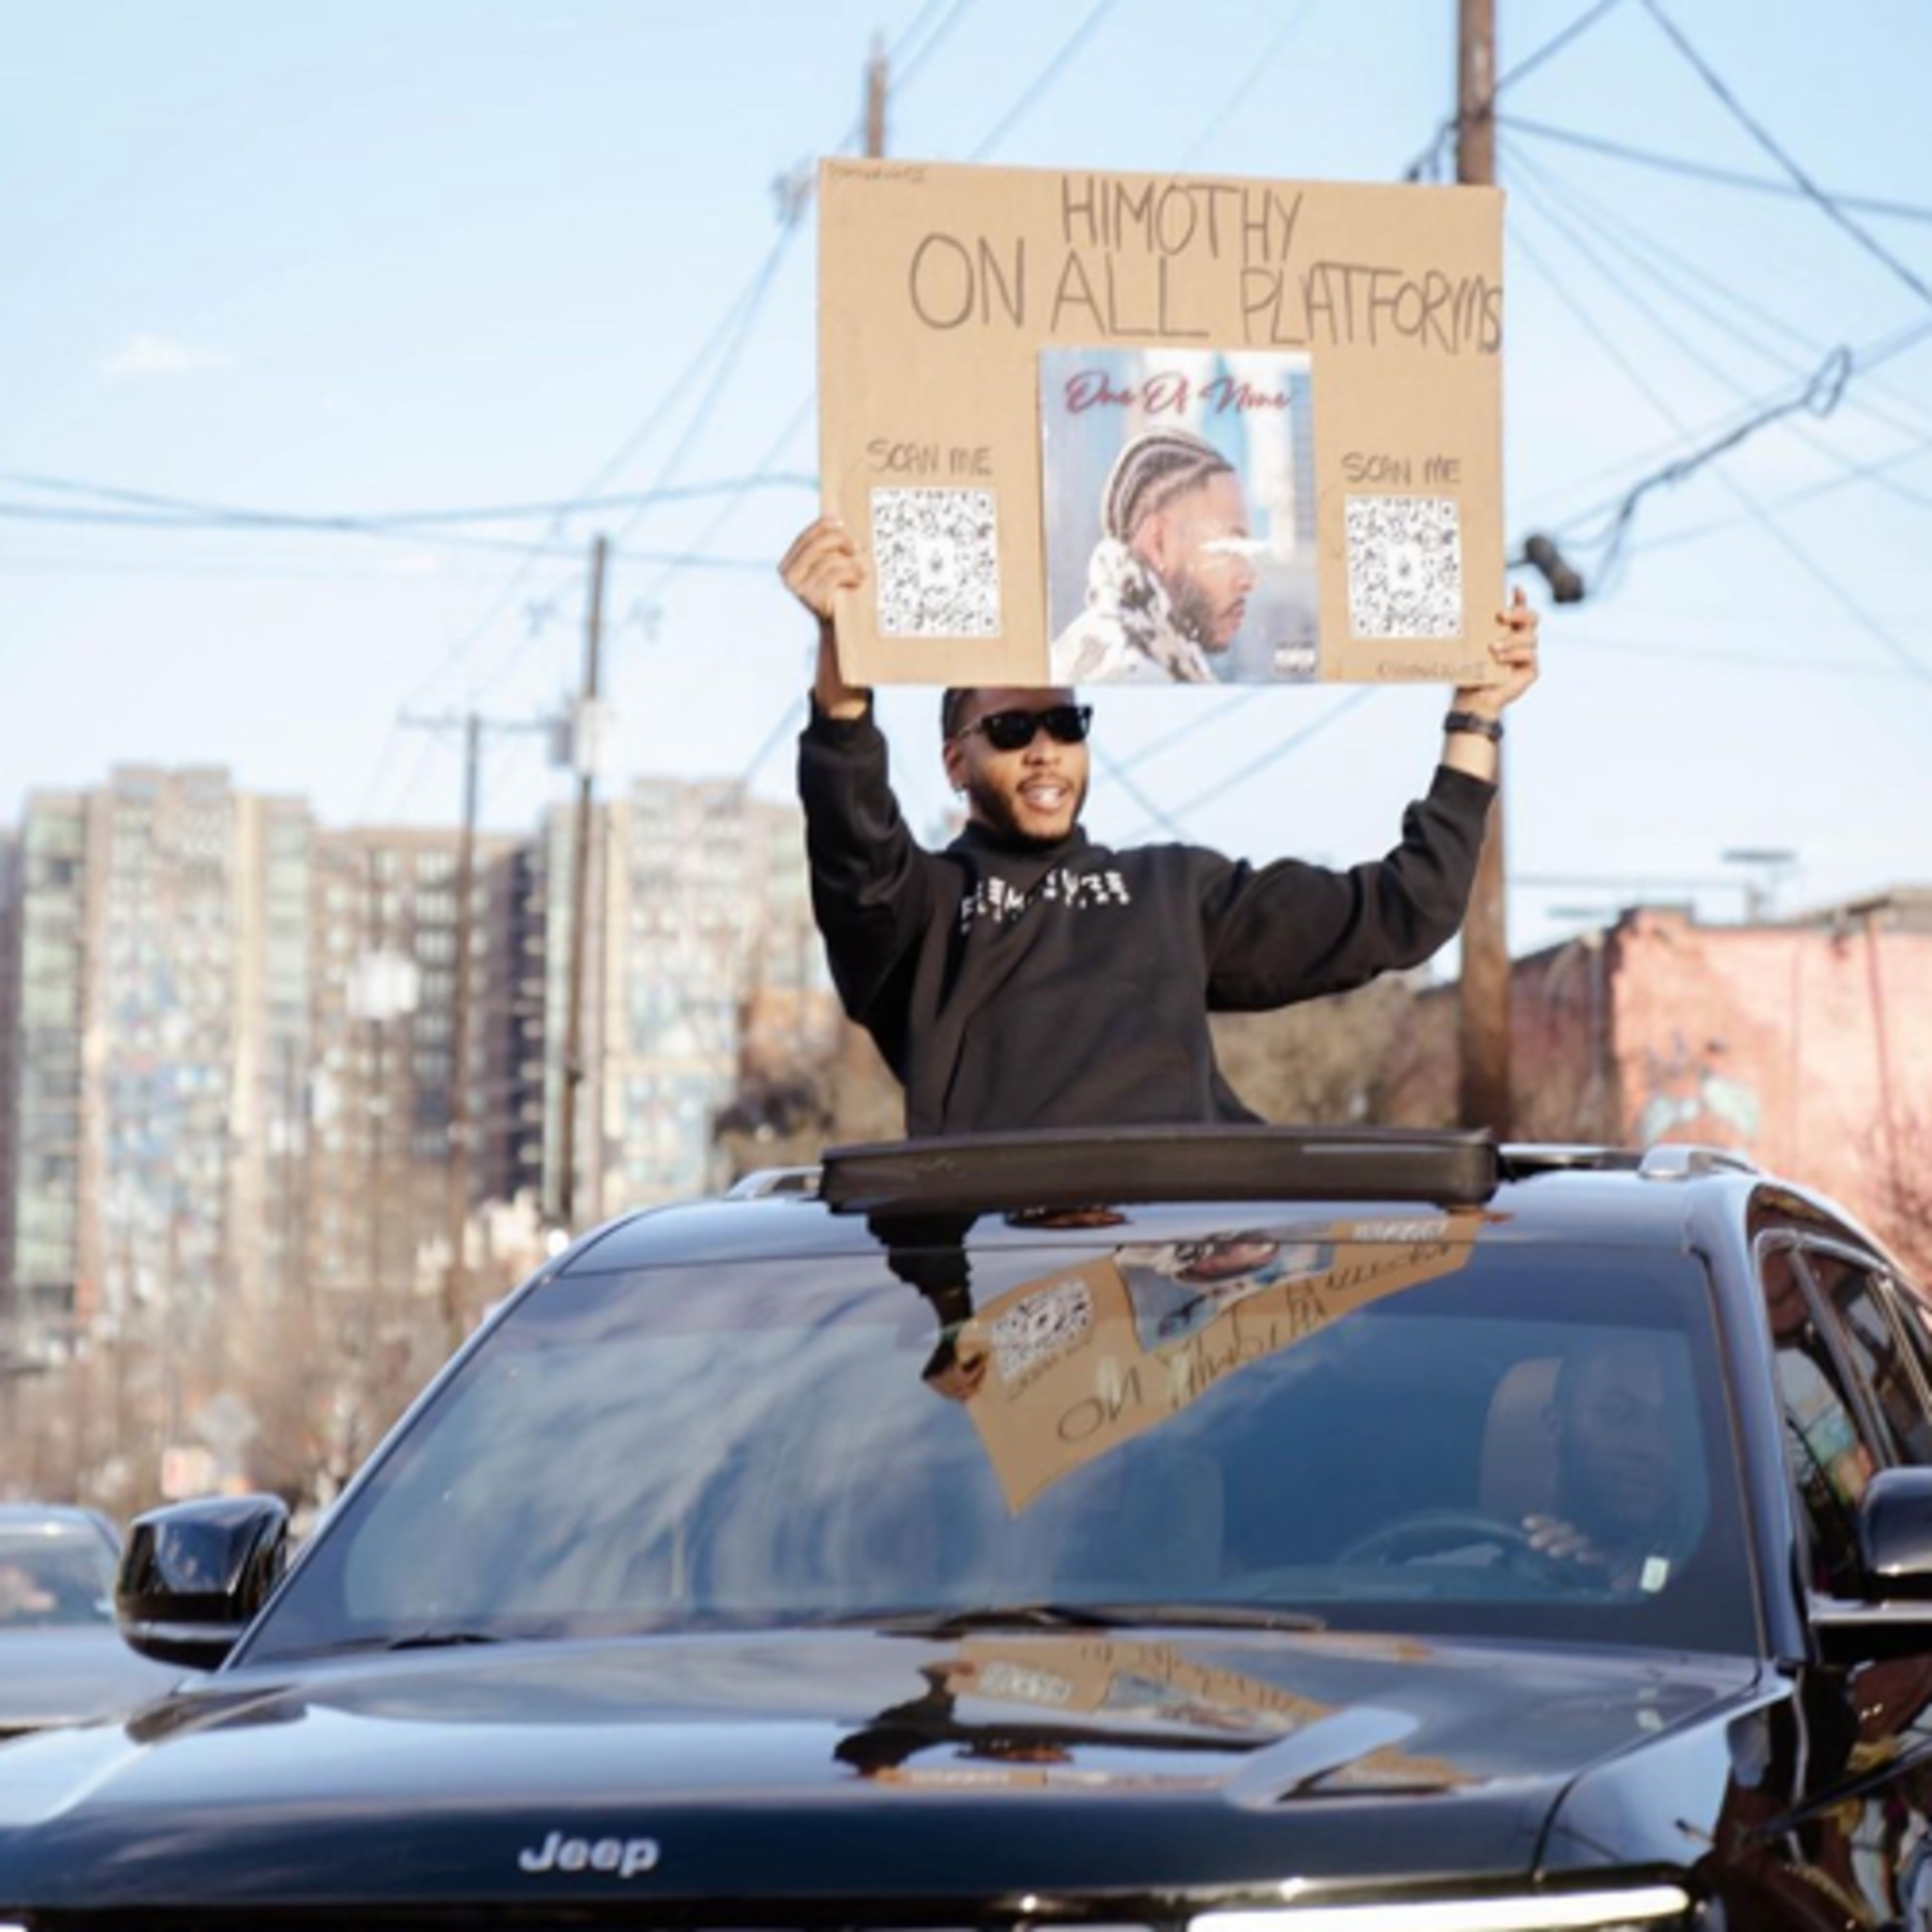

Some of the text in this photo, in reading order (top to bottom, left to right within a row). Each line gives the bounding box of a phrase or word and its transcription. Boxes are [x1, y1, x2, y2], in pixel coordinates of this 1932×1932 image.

[1061, 176, 1303, 264] HIMOTHY
[909, 232, 1504, 355] ON ALL PLATFORMS
[949, 447, 993, 475] ME
[1424, 455, 1462, 484] ME
[518, 1831, 659, 1878] Jeep
